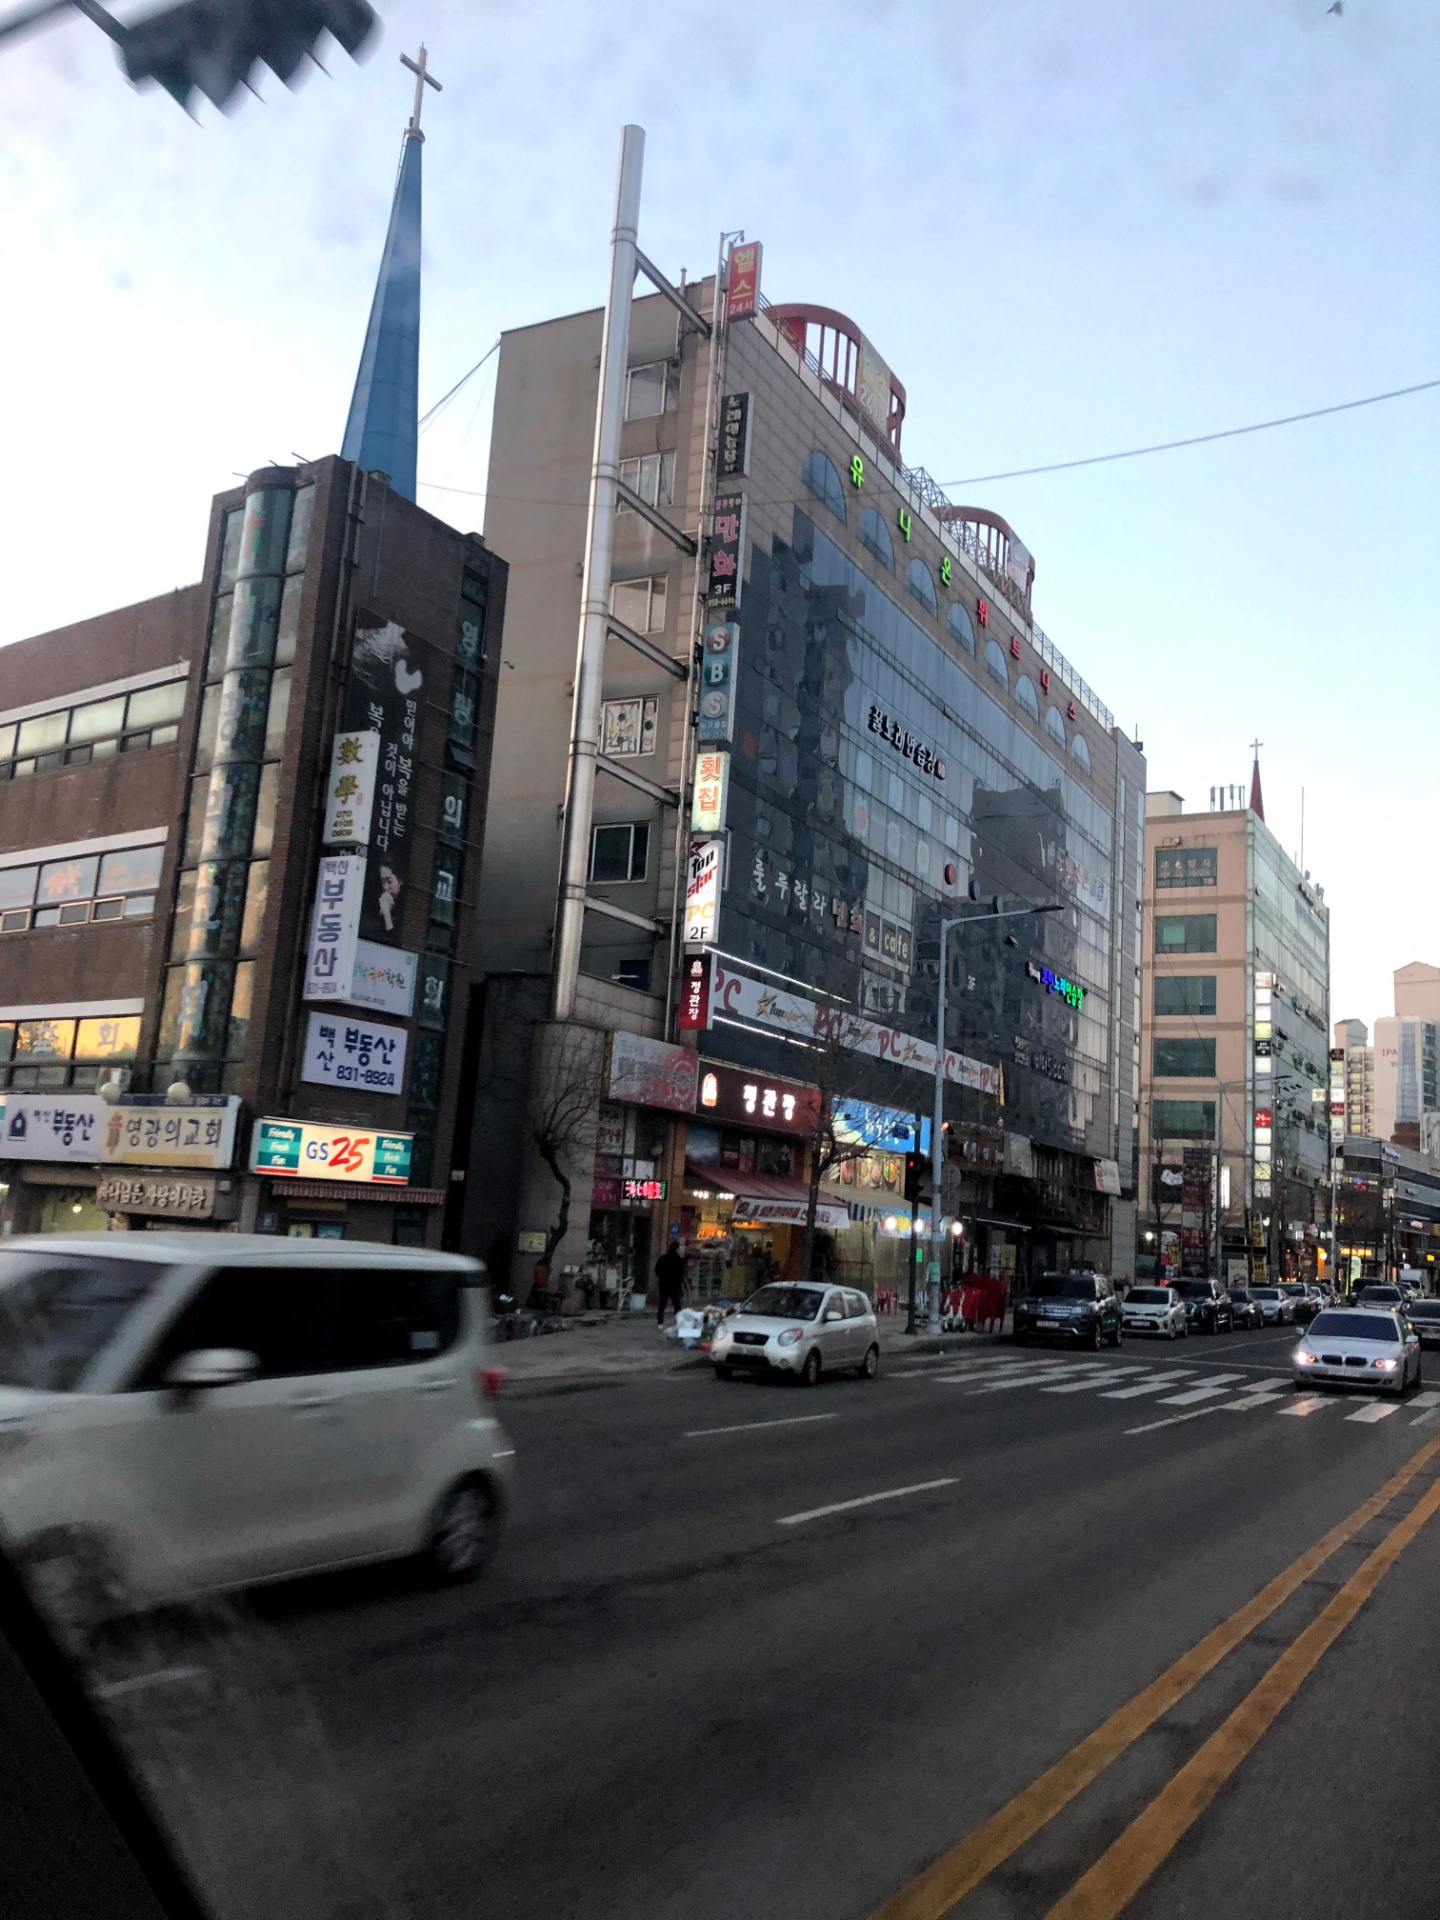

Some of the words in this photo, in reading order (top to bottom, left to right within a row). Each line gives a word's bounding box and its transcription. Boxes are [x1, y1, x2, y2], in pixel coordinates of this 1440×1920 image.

[731, 248, 754, 299] 헬스
[729, 301, 753, 315] 24시
[713, 514, 739, 577] 만화
[714, 583, 732, 595] 3F
[708, 630, 726, 716] SBS
[402, 699, 417, 750] 믿어야
[385, 742, 398, 778] 것이
[397, 755, 414, 797] 복을
[698, 755, 722, 812] 횟집
[377, 783, 395, 853] 아닙니다
[392, 802, 408, 837] 받는
[692, 850, 715, 878] top
[687, 865, 718, 899] star
[314, 878, 346, 978] 부동산
[686, 901, 716, 922] PC
[690, 926, 709, 940] 2F
[868, 928, 877, 944] &
[884, 933, 908, 959] cafe
[688, 981, 702, 1020] 정관장
[344, 1027, 396, 1067] 부동산
[877, 1029, 901, 1059] PC
[336, 1065, 395, 1087] 831-8924
[742, 1085, 796, 1121] 정관장
[52, 1109, 95, 1146] 부동산
[126, 1117, 223, 1148] 영광의교회
[268, 1127, 296, 1142] Friendly
[270, 1155, 286, 1166] Fun
[306, 1136, 371, 1173] GS25
[381, 1139, 406, 1154] Friendly
[384, 1164, 398, 1175] Fun
